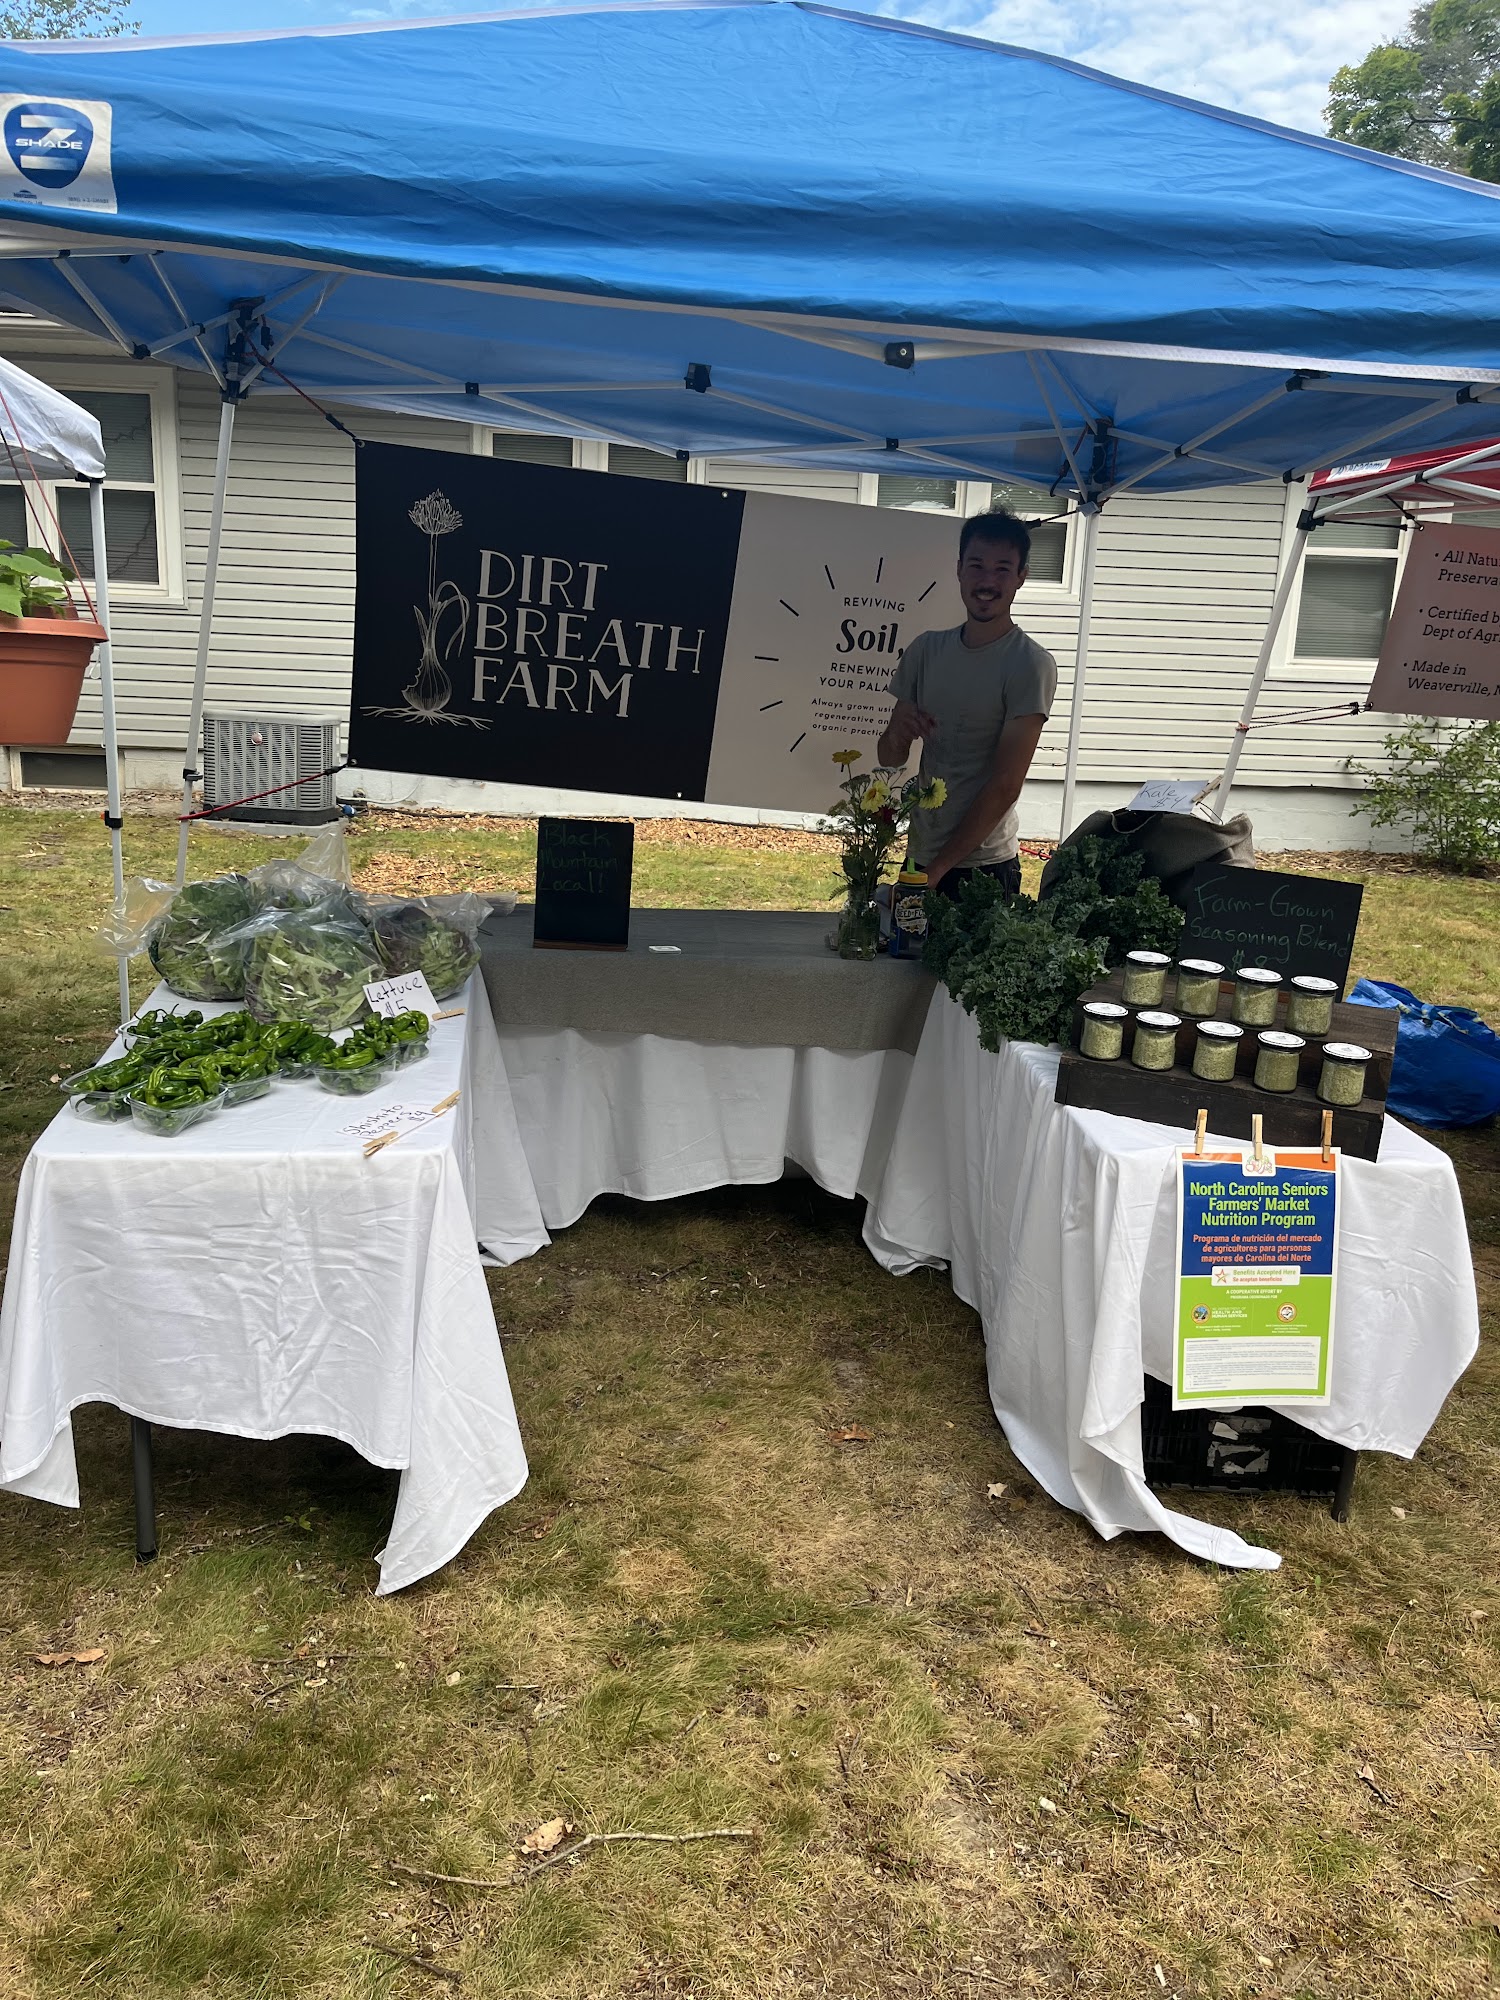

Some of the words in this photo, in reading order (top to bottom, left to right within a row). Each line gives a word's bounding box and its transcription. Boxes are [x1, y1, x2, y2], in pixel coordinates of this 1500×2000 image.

[15, 138, 83, 150] SHADE
[1442, 550, 1464, 564] All
[476, 549, 608, 611] DIRT
[844, 597, 906, 613] REVIVING
[1427, 605, 1490, 623] Certified
[474, 602, 706, 674] BREATH
[836, 618, 904, 661] Soil,
[1422, 624, 1455, 640] Dept
[1457, 628, 1475, 640] of
[1412, 660, 1450, 675] Made
[1452, 663, 1467, 676] in
[471, 655, 634, 718] FARM
[819, 676, 854, 689] YOUR
[858, 681, 889, 693] PALA
[1408, 677, 1491, 697] Weaverville,
[811, 697, 843, 709] Always
[847, 703, 875, 711] grown
[878, 705, 895, 713] usi
[814, 711, 874, 724] regenerative
[812, 723, 848, 733] organic
[850, 727, 883, 737] practic
[1139, 783, 1177, 799] Kale
[1151, 794, 1187, 809] $4
[543, 823, 610, 848] Black
[539, 847, 618, 872] Mountain
[1194, 876, 1335, 920] Farm-Grown
[1190, 917, 1291, 964] Seasoning
[1296, 924, 1351, 958] Blend
[366, 975, 423, 1003] Lettuce
[343, 1104, 403, 1135] Shishito
[1190, 1182, 1225, 1196] North
[1228, 1182, 1279, 1196] Carolina
[1282, 1182, 1328, 1196] Seniors
[1209, 1197, 1262, 1211] Farmers'
[1265, 1197, 1310, 1211] Market
[1201, 1212, 1258, 1226] Nutrition
[1261, 1213, 1316, 1229] Program
[1193, 1234, 1229, 1245] Programa
[1231, 1234, 1240, 1242] de
[1242, 1234, 1275, 1242] nutrición
[1276, 1234, 1288, 1242] del
[1290, 1234, 1322, 1242] mercado
[1202, 1244, 1212, 1252] de
[1214, 1244, 1258, 1254] agricultores
[1260, 1245, 1276, 1254] para
[1277, 1245, 1311, 1254] personas
[1201, 1255, 1232, 1264] mayores
[1234, 1254, 1243, 1262] de
[1245, 1254, 1276, 1262] Carolina
[1278, 1254, 1289, 1262] del
[1291, 1254, 1312, 1262] Norte
[1257, 1269, 1282, 1277] Accepted
